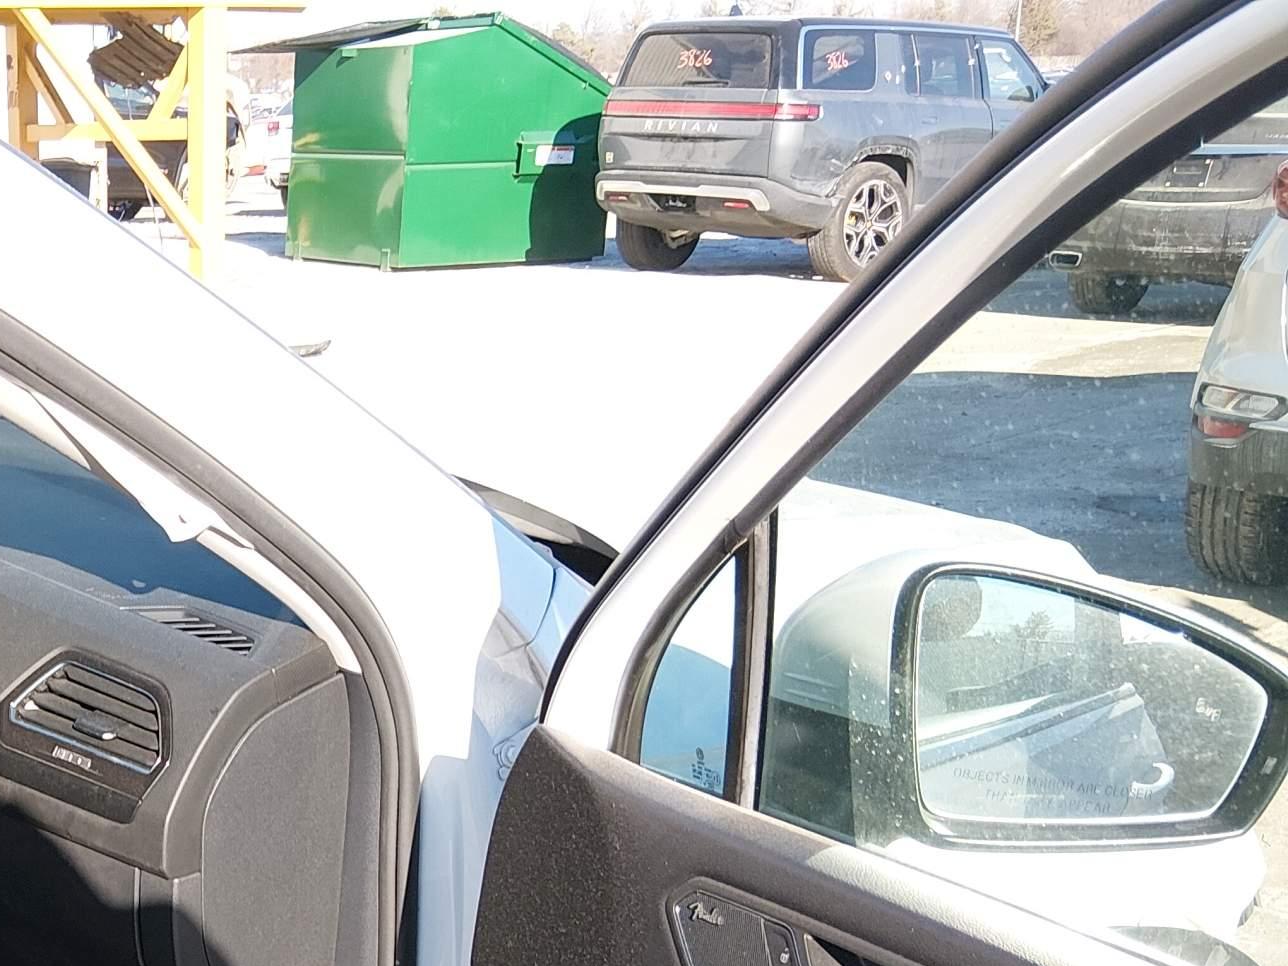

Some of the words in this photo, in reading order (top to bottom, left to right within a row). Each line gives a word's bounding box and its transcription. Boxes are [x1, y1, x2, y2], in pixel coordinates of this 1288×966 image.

[677, 49, 713, 69] 3826
[825, 51, 850, 71] 3826
[644, 119, 719, 133] RIVIAN
[953, 767, 1010, 785] OBJECTS
[1012, 774, 1026, 785] IN
[1078, 783, 1102, 796] ARE
